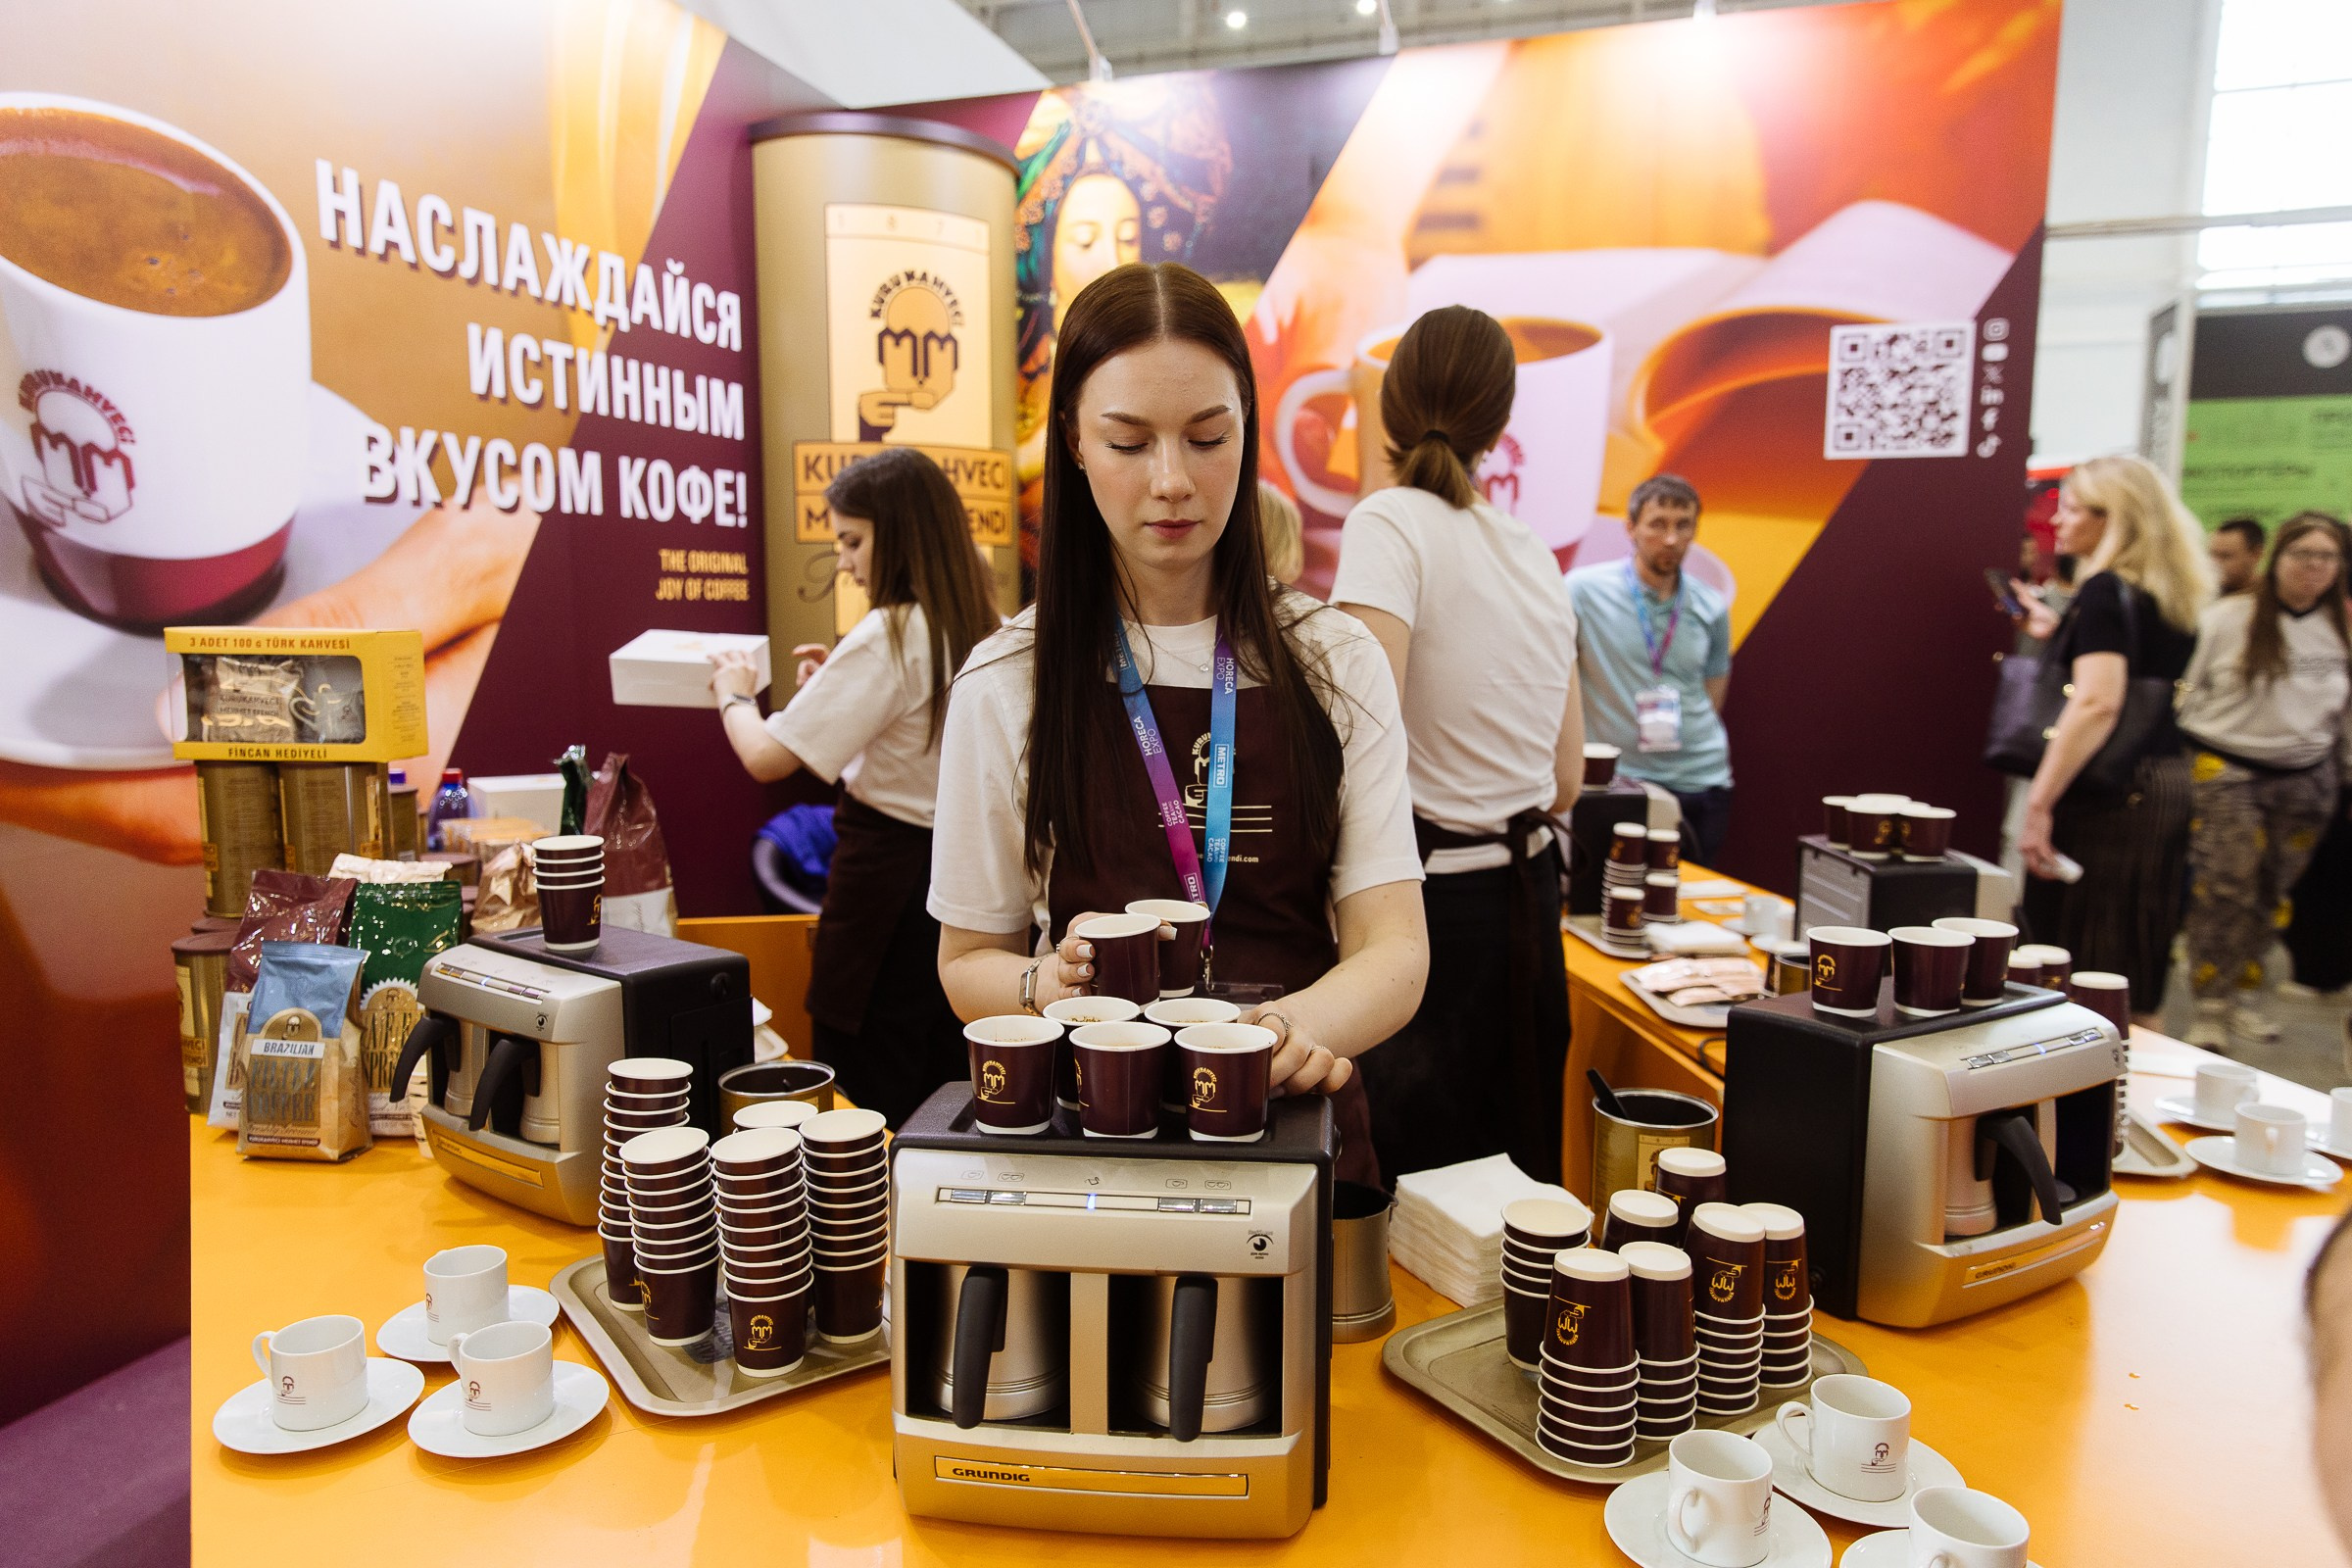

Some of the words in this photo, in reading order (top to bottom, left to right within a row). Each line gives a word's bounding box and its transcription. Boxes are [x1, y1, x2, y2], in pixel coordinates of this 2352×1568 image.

[316, 158, 743, 351] НАСЛАЖДАЙСЯ
[466, 321, 745, 441] ИСТИННЫМ
[364, 421, 604, 516] ВКУСОМ
[618, 455, 748, 528] КОФЕ!
[659, 549, 686, 572] THE
[688, 550, 749, 574] ORIGINAL
[656, 577, 684, 600] JOY
[685, 577, 703, 601] OF
[190, 637, 196, 647] 3
[200, 637, 227, 648] ADET
[233, 638, 252, 648] 100
[267, 637, 295, 649] TÜRK
[1216, 657, 1225, 680] EXPO
[1225, 658, 1234, 695] HORECA
[1134, 715, 1152, 756] HORECA
[1148, 728, 1162, 755] EXPO
[228, 747, 270, 759] FİNCAN
[1216, 747, 1226, 785] METRO
[1162, 802, 1172, 827] COFFEE
[1173, 800, 1184, 824] CACAO
[264, 1042, 315, 1055] BRAZILIAN
[953, 1467, 1030, 1482] GRUNDIG
